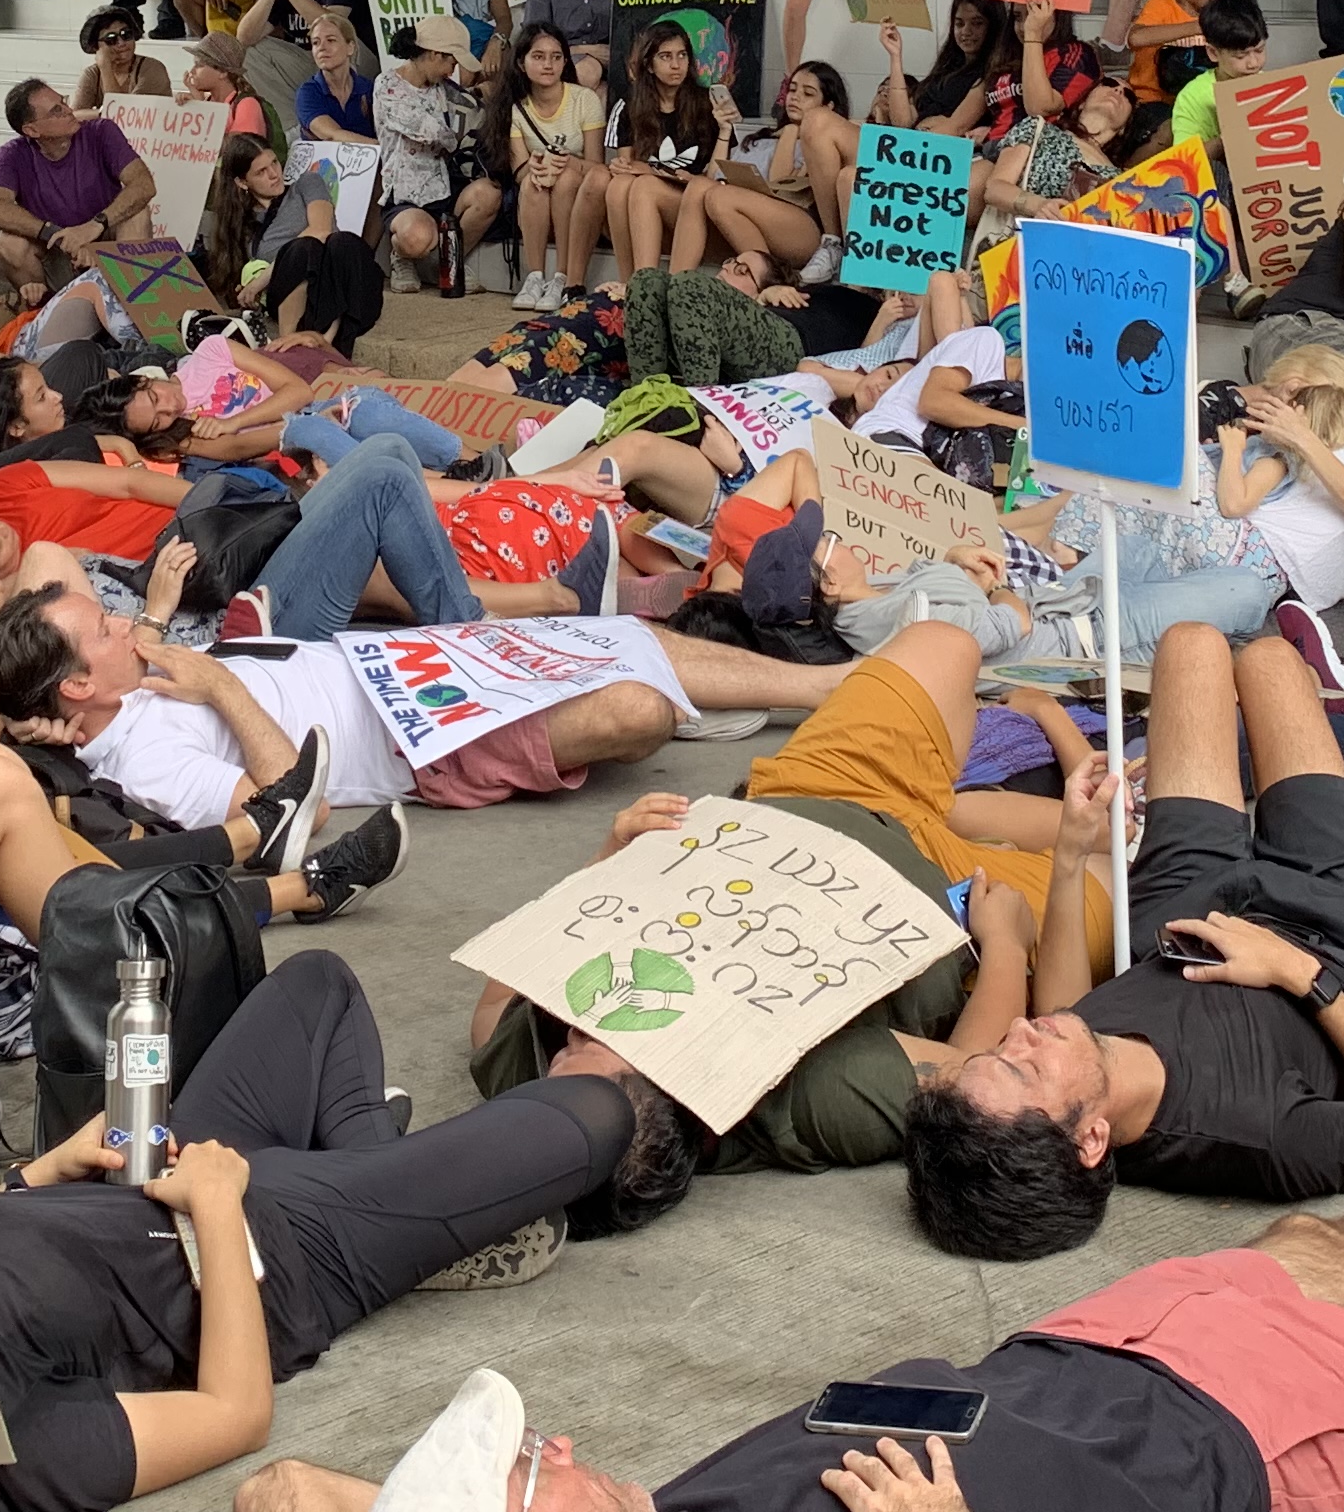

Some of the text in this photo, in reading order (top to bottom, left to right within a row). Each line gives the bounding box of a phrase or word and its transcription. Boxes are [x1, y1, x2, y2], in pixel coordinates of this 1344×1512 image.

[164, 111, 215, 141] UPS!
[1235, 75, 1321, 171] NOT
[876, 134, 952, 175] Rain
[854, 168, 968, 217] Forests
[869, 206, 932, 236] Not
[1242, 180, 1289, 243] FOR
[843, 231, 957, 274] Rolexes
[420, 393, 516, 441] JUSTICE
[702, 385, 779, 451] RANUS
[843, 437, 966, 510] YOU CAN
[831, 464, 986, 547] IGNORE US
[846, 509, 886, 538] BUT
[900, 532, 936, 560] YOU
[353, 641, 434, 748] THE TIME IS
[384, 640, 488, 728] NOW
